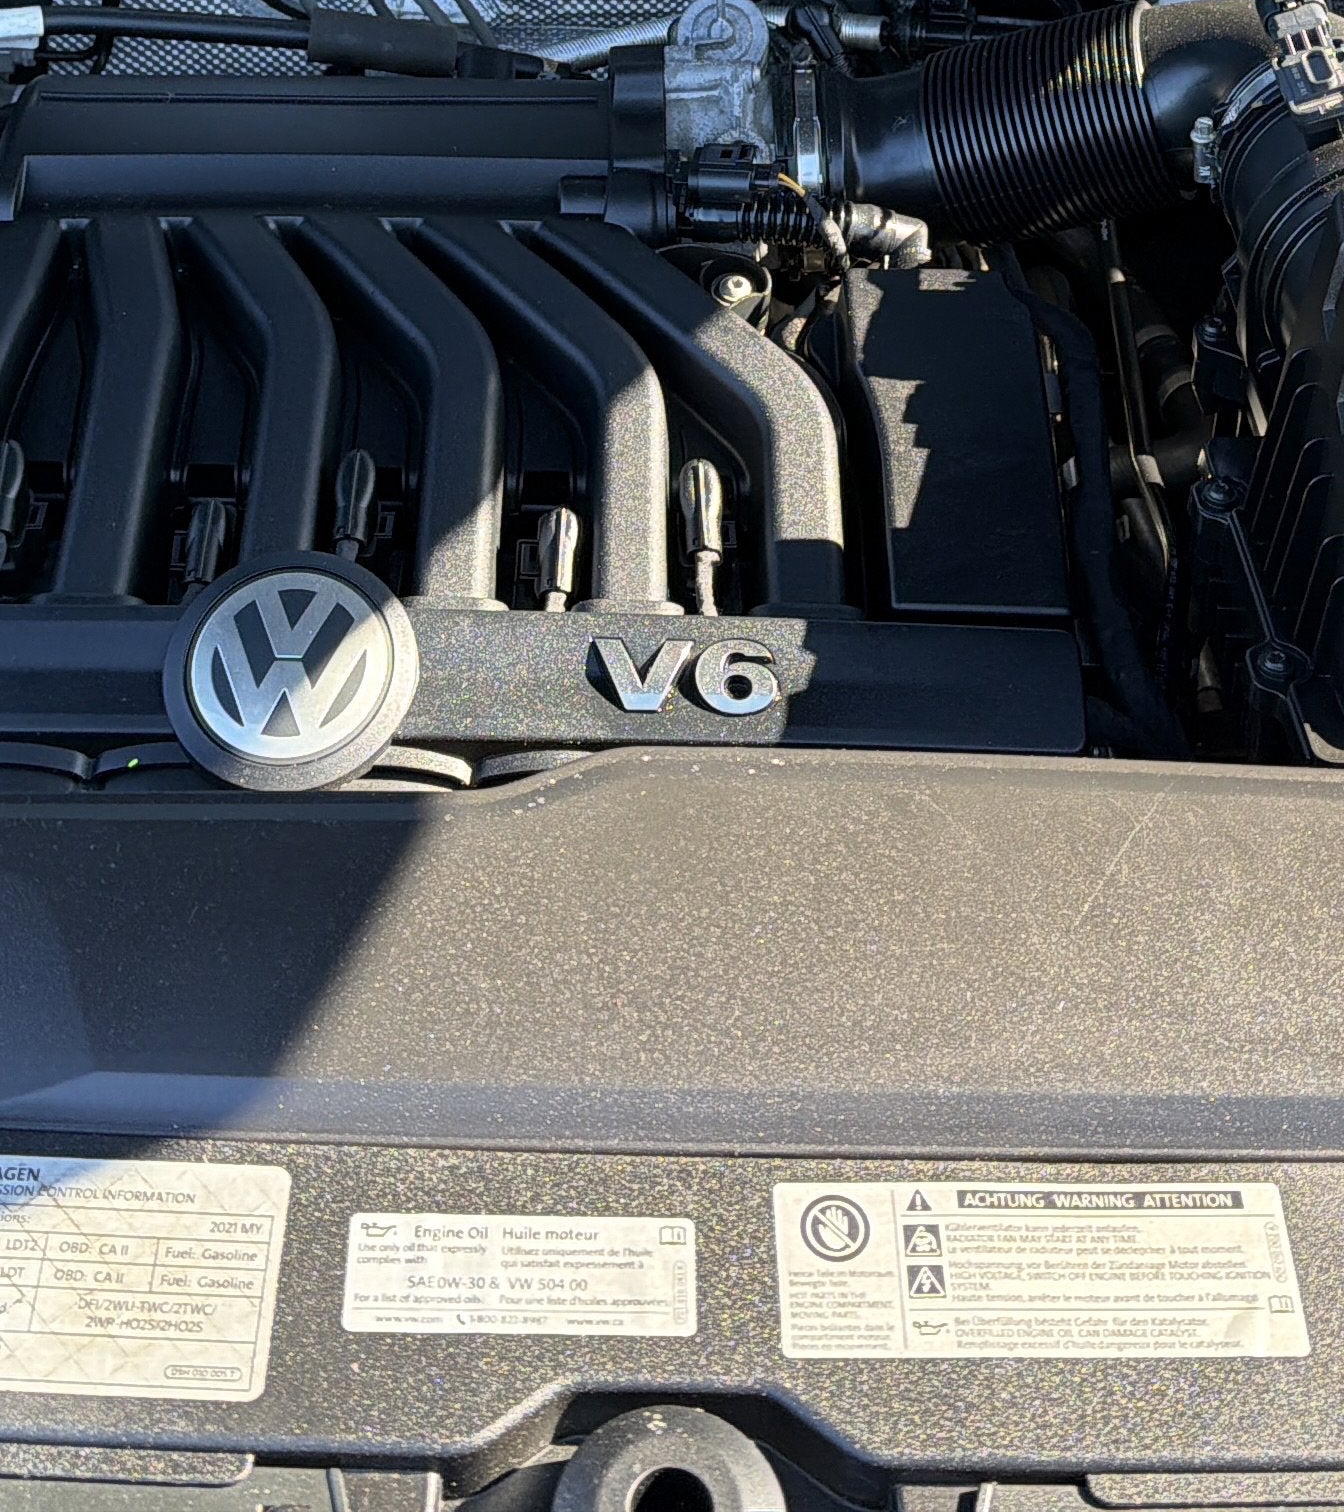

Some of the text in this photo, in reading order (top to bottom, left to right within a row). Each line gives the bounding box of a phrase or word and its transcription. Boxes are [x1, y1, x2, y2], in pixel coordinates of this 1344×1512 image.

[591, 636, 779, 716] V6
[38, 1185, 99, 1200] CONTROL
[103, 1188, 196, 1204] INFORMATION
[963, 1192, 1233, 1208] ACHTUNG WARNING ATTENTION
[209, 1221, 262, 1235] 2021 MY
[413, 1225, 600, 1242] Engine Oil Huile moteur
[99, 1243, 118, 1255] CA
[165, 1246, 258, 1262] Fuel: Gasoline
[94, 1270, 113, 1283] CA
[160, 1274, 254, 1291] Fuel: Gasoline
[407, 1275, 588, 1291] SAE 0W-30 & VW 504 00
